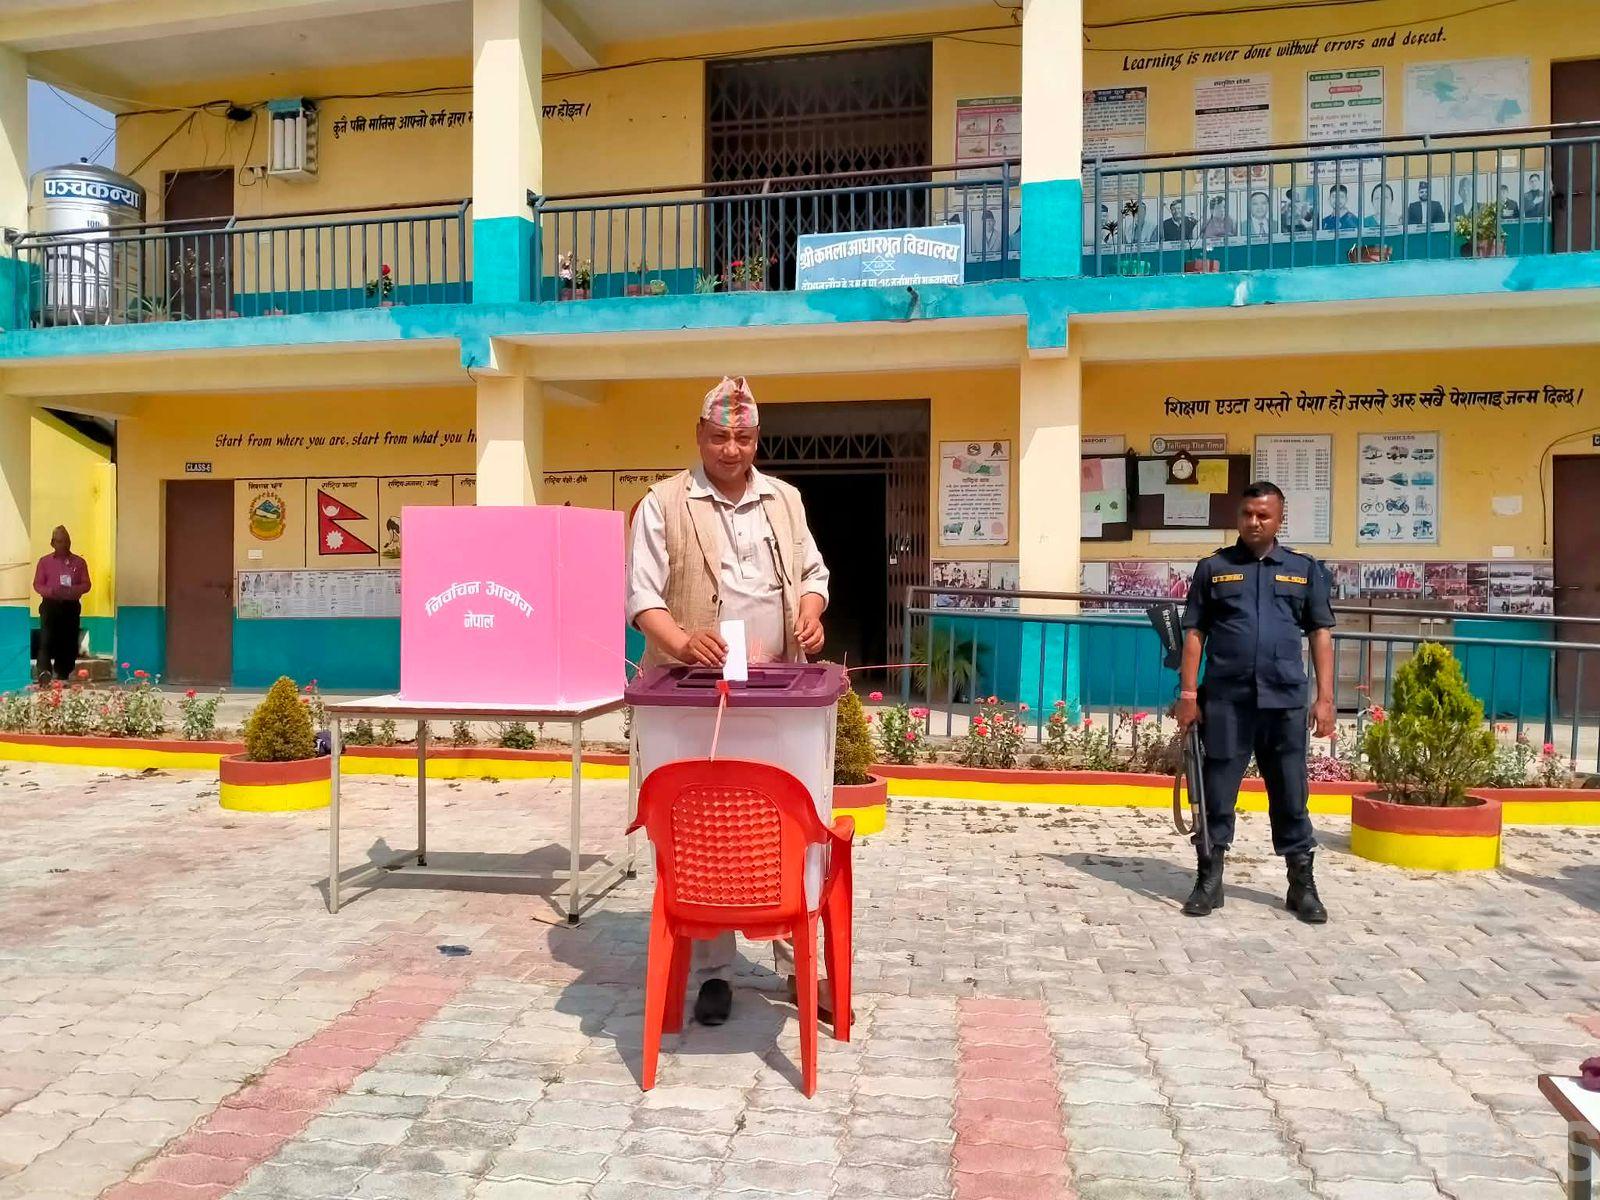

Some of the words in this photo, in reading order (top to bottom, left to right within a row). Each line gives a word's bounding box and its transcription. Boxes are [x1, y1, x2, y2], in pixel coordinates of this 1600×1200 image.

[1122, 52, 1184, 71] Learning
[1187, 51, 1200, 65] is
[1202, 50, 1240, 63] never
[1243, 44, 1272, 60] done
[1276, 38, 1319, 57] without
[1324, 38, 1366, 52] errors
[1371, 32, 1397, 48] and
[1402, 26, 1447, 46] defeat.
[350, 115, 366, 132] पनि
[368, 115, 397, 132] मानिस
[429, 109, 446, 127] कर्म
[44, 179, 140, 208] पञ्चकन्या
[799, 245, 815, 271] श्री
[847, 236, 900, 258] आधारभूत
[903, 234, 960, 264] विद्यालय
[1164, 396, 1211, 419] शिक्षण
[1215, 398, 1250, 415] एउटा
[1254, 391, 1293, 417] यस्तो
[1296, 390, 1327, 415] पेशा
[1328, 389, 1346, 416] हो
[1346, 388, 1389, 415] जसले
[1390, 393, 1416, 411] अरु
[1418, 385, 1446, 410] सबै
[1503, 389, 1539, 406] जन्म
[216, 433, 243, 448] Start
[247, 433, 272, 447] from
[276, 433, 304, 447] where
[305, 435, 326, 449] you
[351, 431, 380, 446] start
[383, 430, 408, 445] from
[412, 430, 440, 445] what
[440, 432, 463, 447] you
[425, 581, 481, 617] निर्वाचन
[485, 581, 534, 618] आयोग
[464, 611, 495, 628] नेपाल
